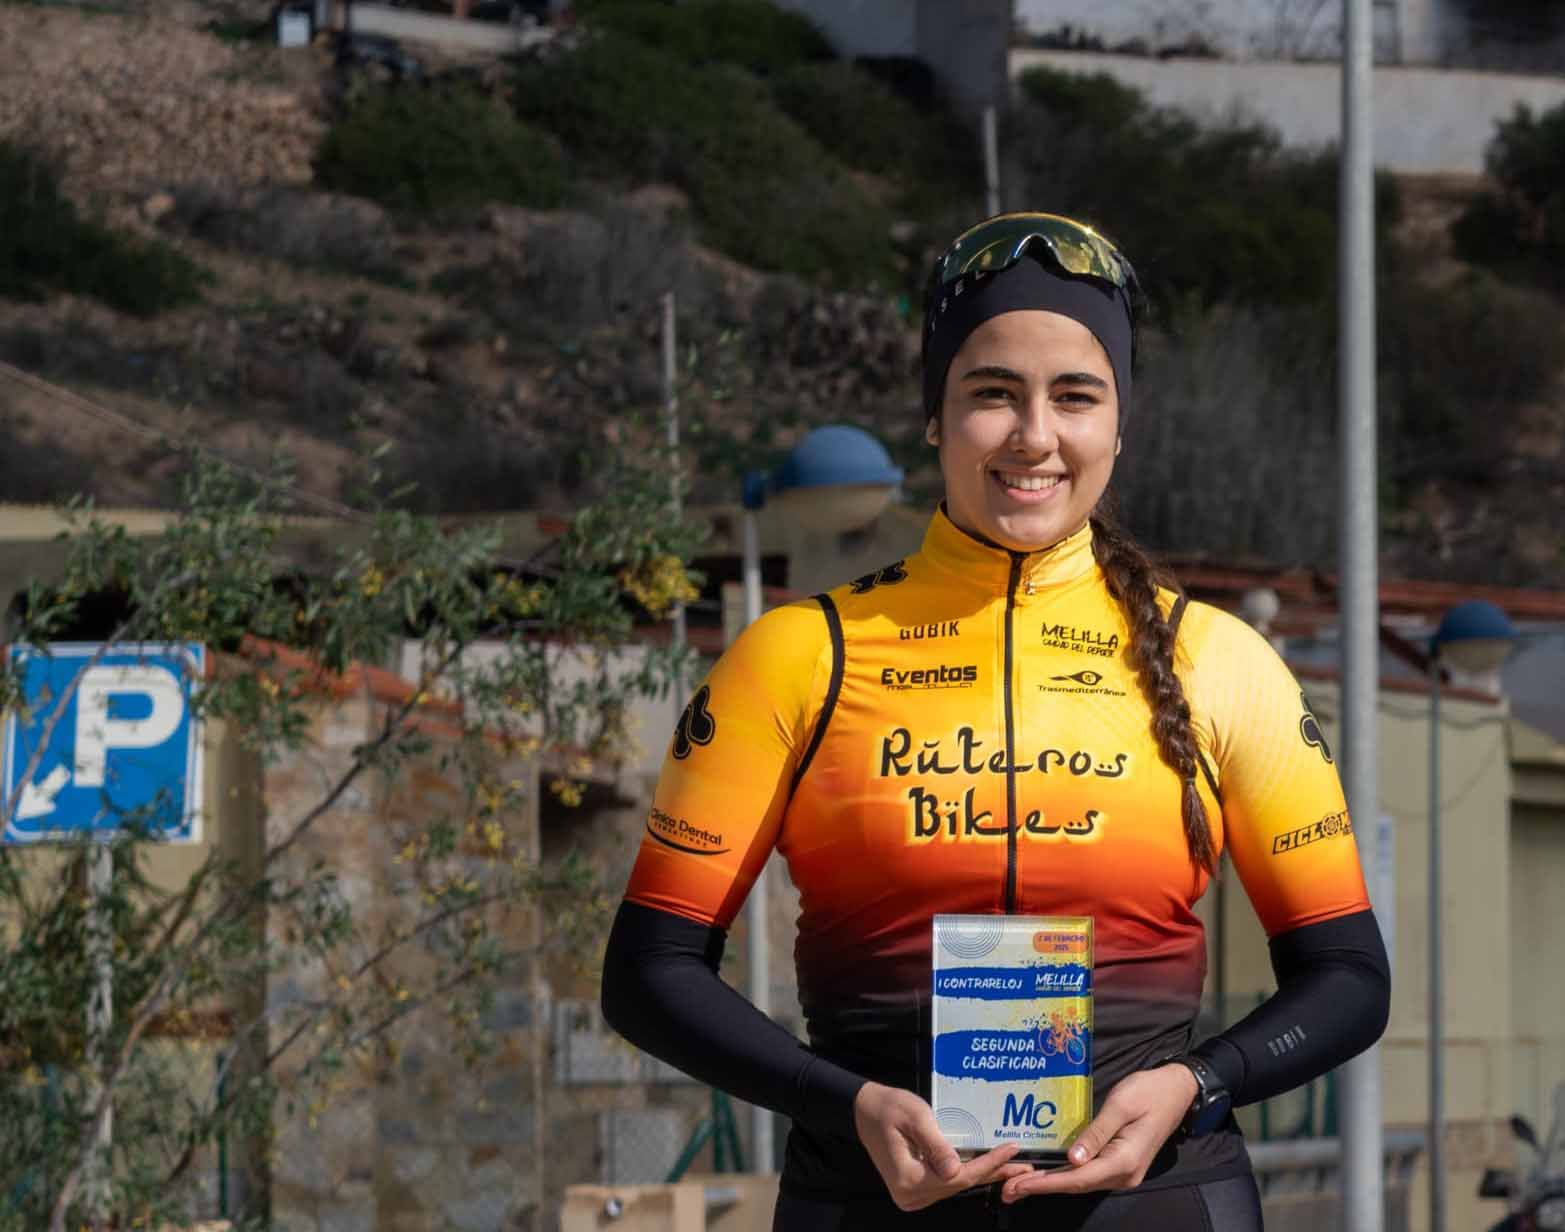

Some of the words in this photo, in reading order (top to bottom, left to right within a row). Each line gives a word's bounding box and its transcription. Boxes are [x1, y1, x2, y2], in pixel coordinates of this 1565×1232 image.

[1041, 621, 1119, 649] MELILLA
[881, 664, 977, 686] Eventos
[74, 664, 186, 789] P
[679, 820, 722, 845] Dental
[943, 976, 1023, 990] CONTRARELOJ
[1035, 973, 1085, 987] MELILLA
[971, 1037, 1036, 1053] SEGUNDA
[962, 1055, 1046, 1070] CLASIFICADA
